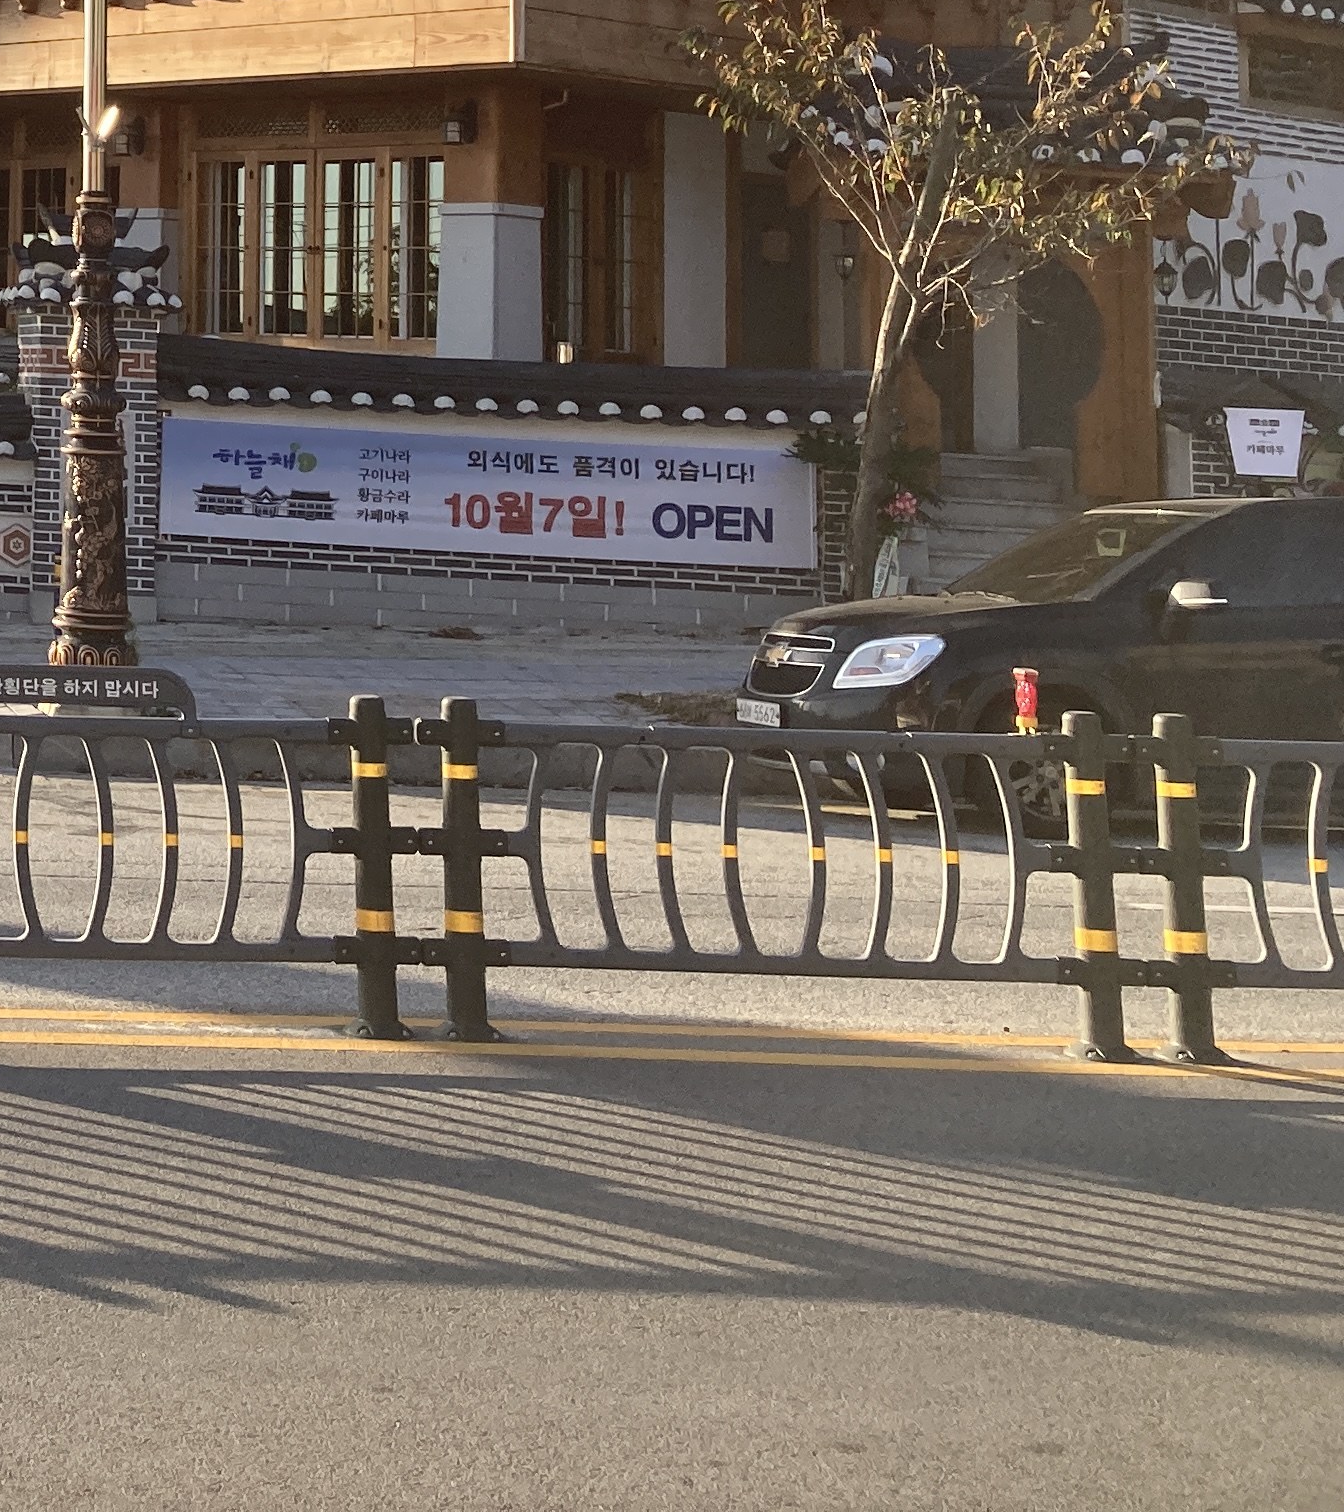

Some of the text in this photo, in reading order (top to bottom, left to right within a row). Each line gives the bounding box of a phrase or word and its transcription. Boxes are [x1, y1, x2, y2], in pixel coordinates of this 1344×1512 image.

[213, 448, 296, 479] 하늘채
[358, 448, 411, 464] 고기나라
[358, 467, 411, 484] 구이나라
[467, 450, 754, 485] 외식에도 품격이 있습니다!
[356, 488, 411, 505] 황금수라
[356, 508, 410, 525] 카페마루
[444, 491, 774, 544] 10월7일! OPEN
[64, 679, 99, 697] 하지
[105, 680, 159, 699] 맙시다
